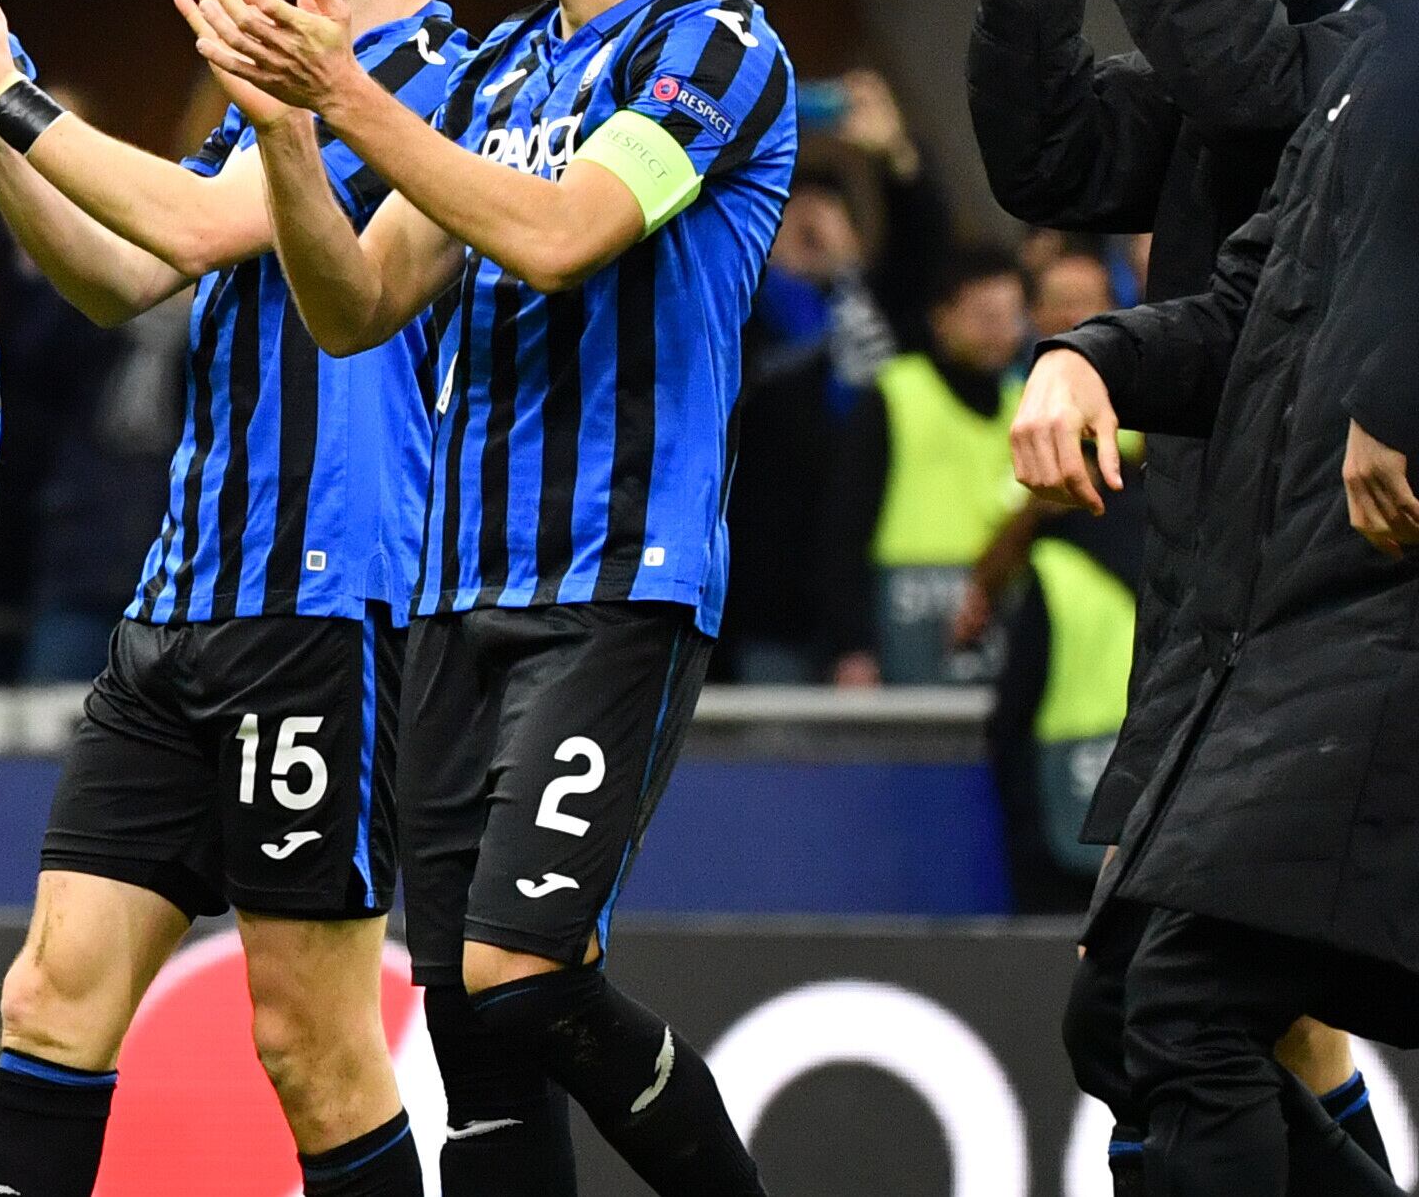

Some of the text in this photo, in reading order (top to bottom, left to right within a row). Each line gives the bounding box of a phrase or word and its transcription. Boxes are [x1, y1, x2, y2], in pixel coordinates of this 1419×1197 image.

[677, 90, 733, 137] RESPECT
[235, 712, 329, 811] 15
[534, 735, 607, 838] 2
